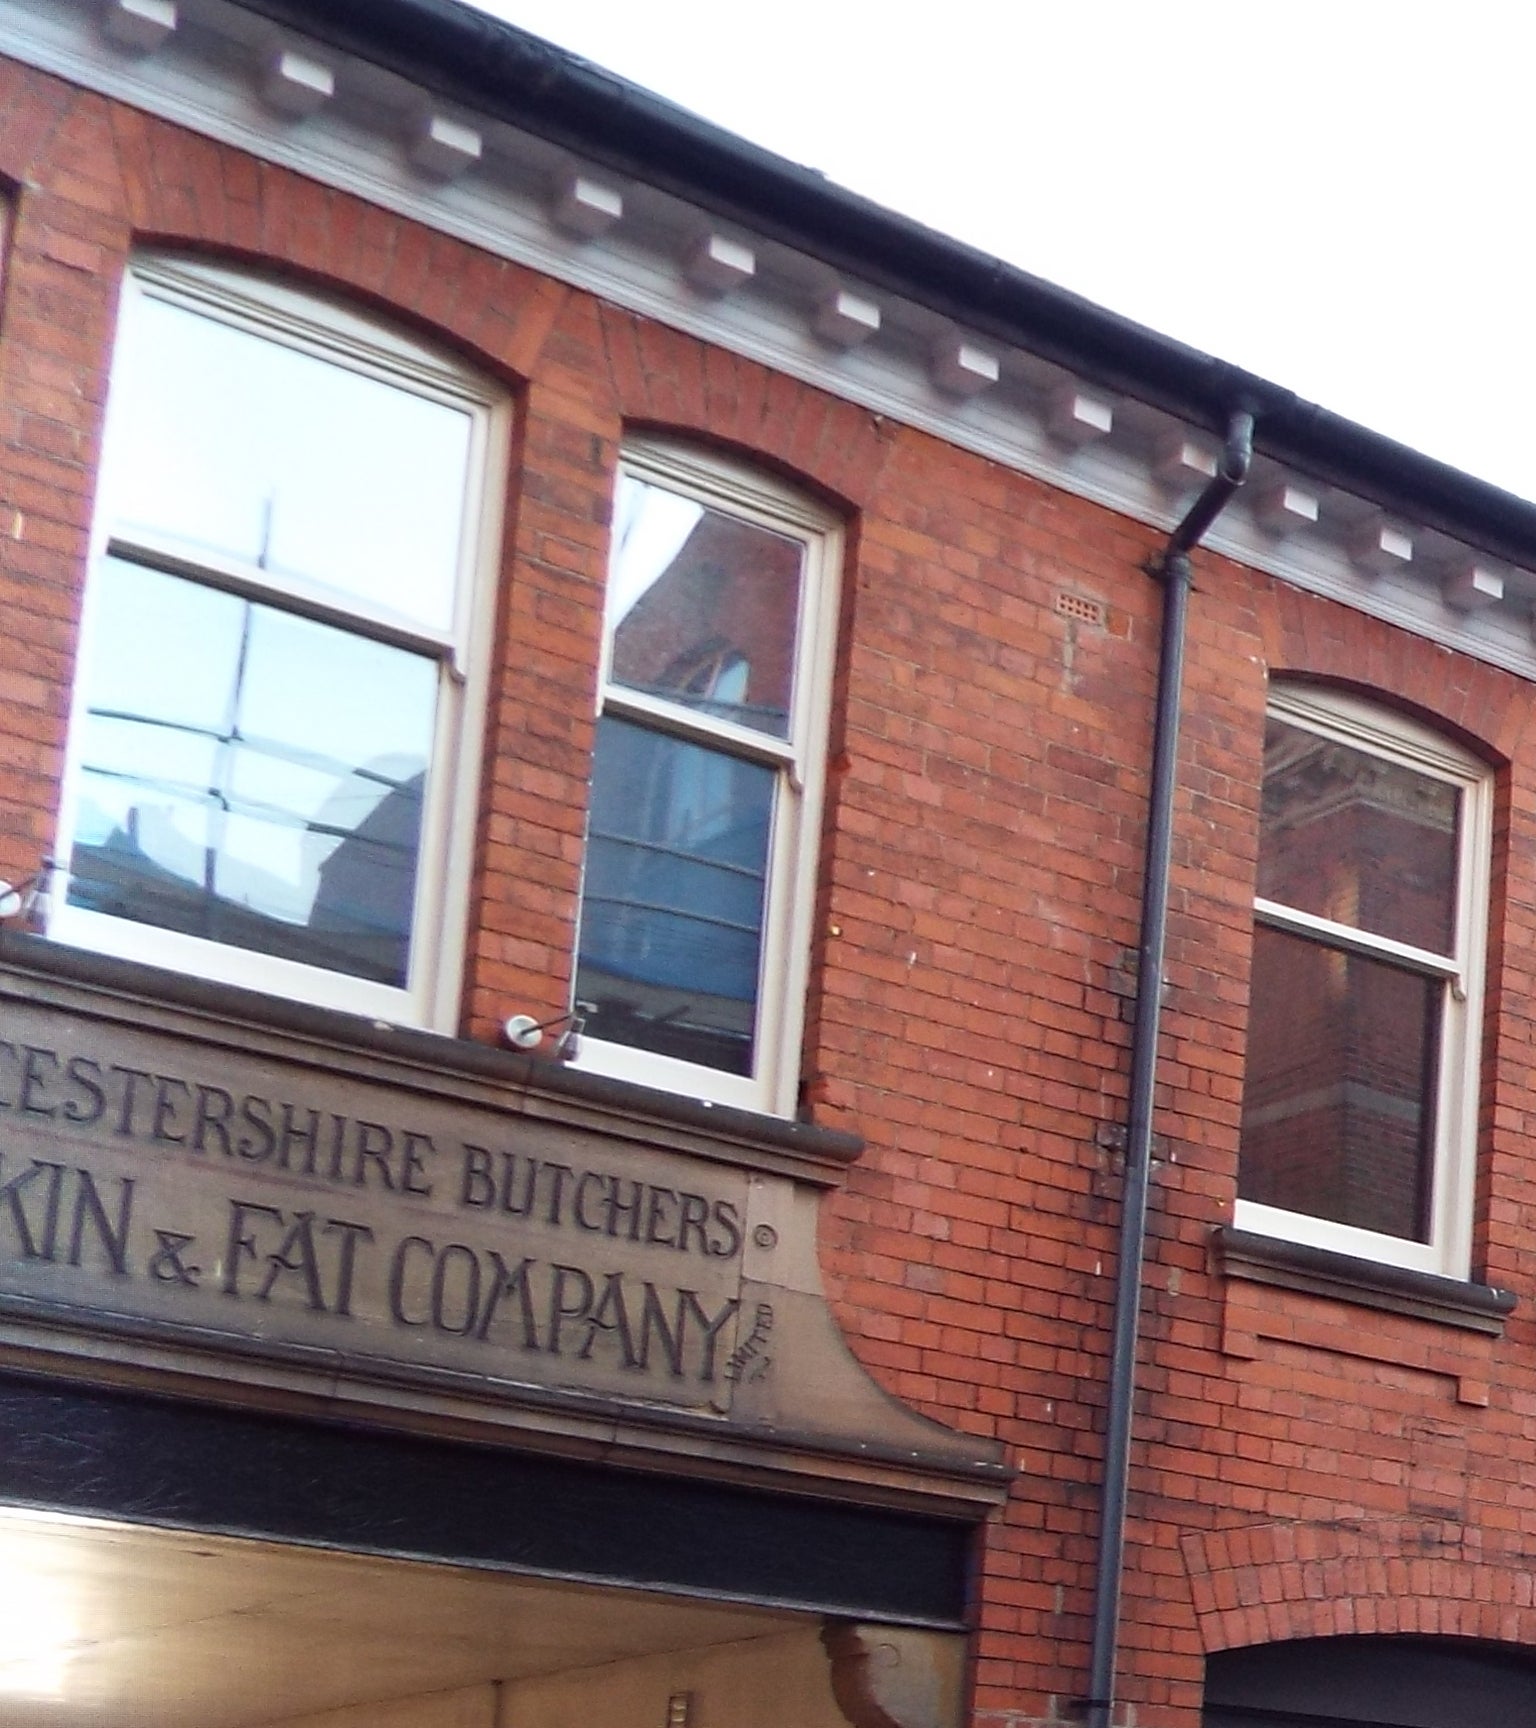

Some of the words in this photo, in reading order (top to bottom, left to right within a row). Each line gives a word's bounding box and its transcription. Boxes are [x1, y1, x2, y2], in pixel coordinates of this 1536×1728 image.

[461, 1143, 743, 1261] BUTCHERS
[150, 1228, 201, 1287] &
[221, 1198, 375, 1318] FAT
[388, 1235, 743, 1382] COMPANY
